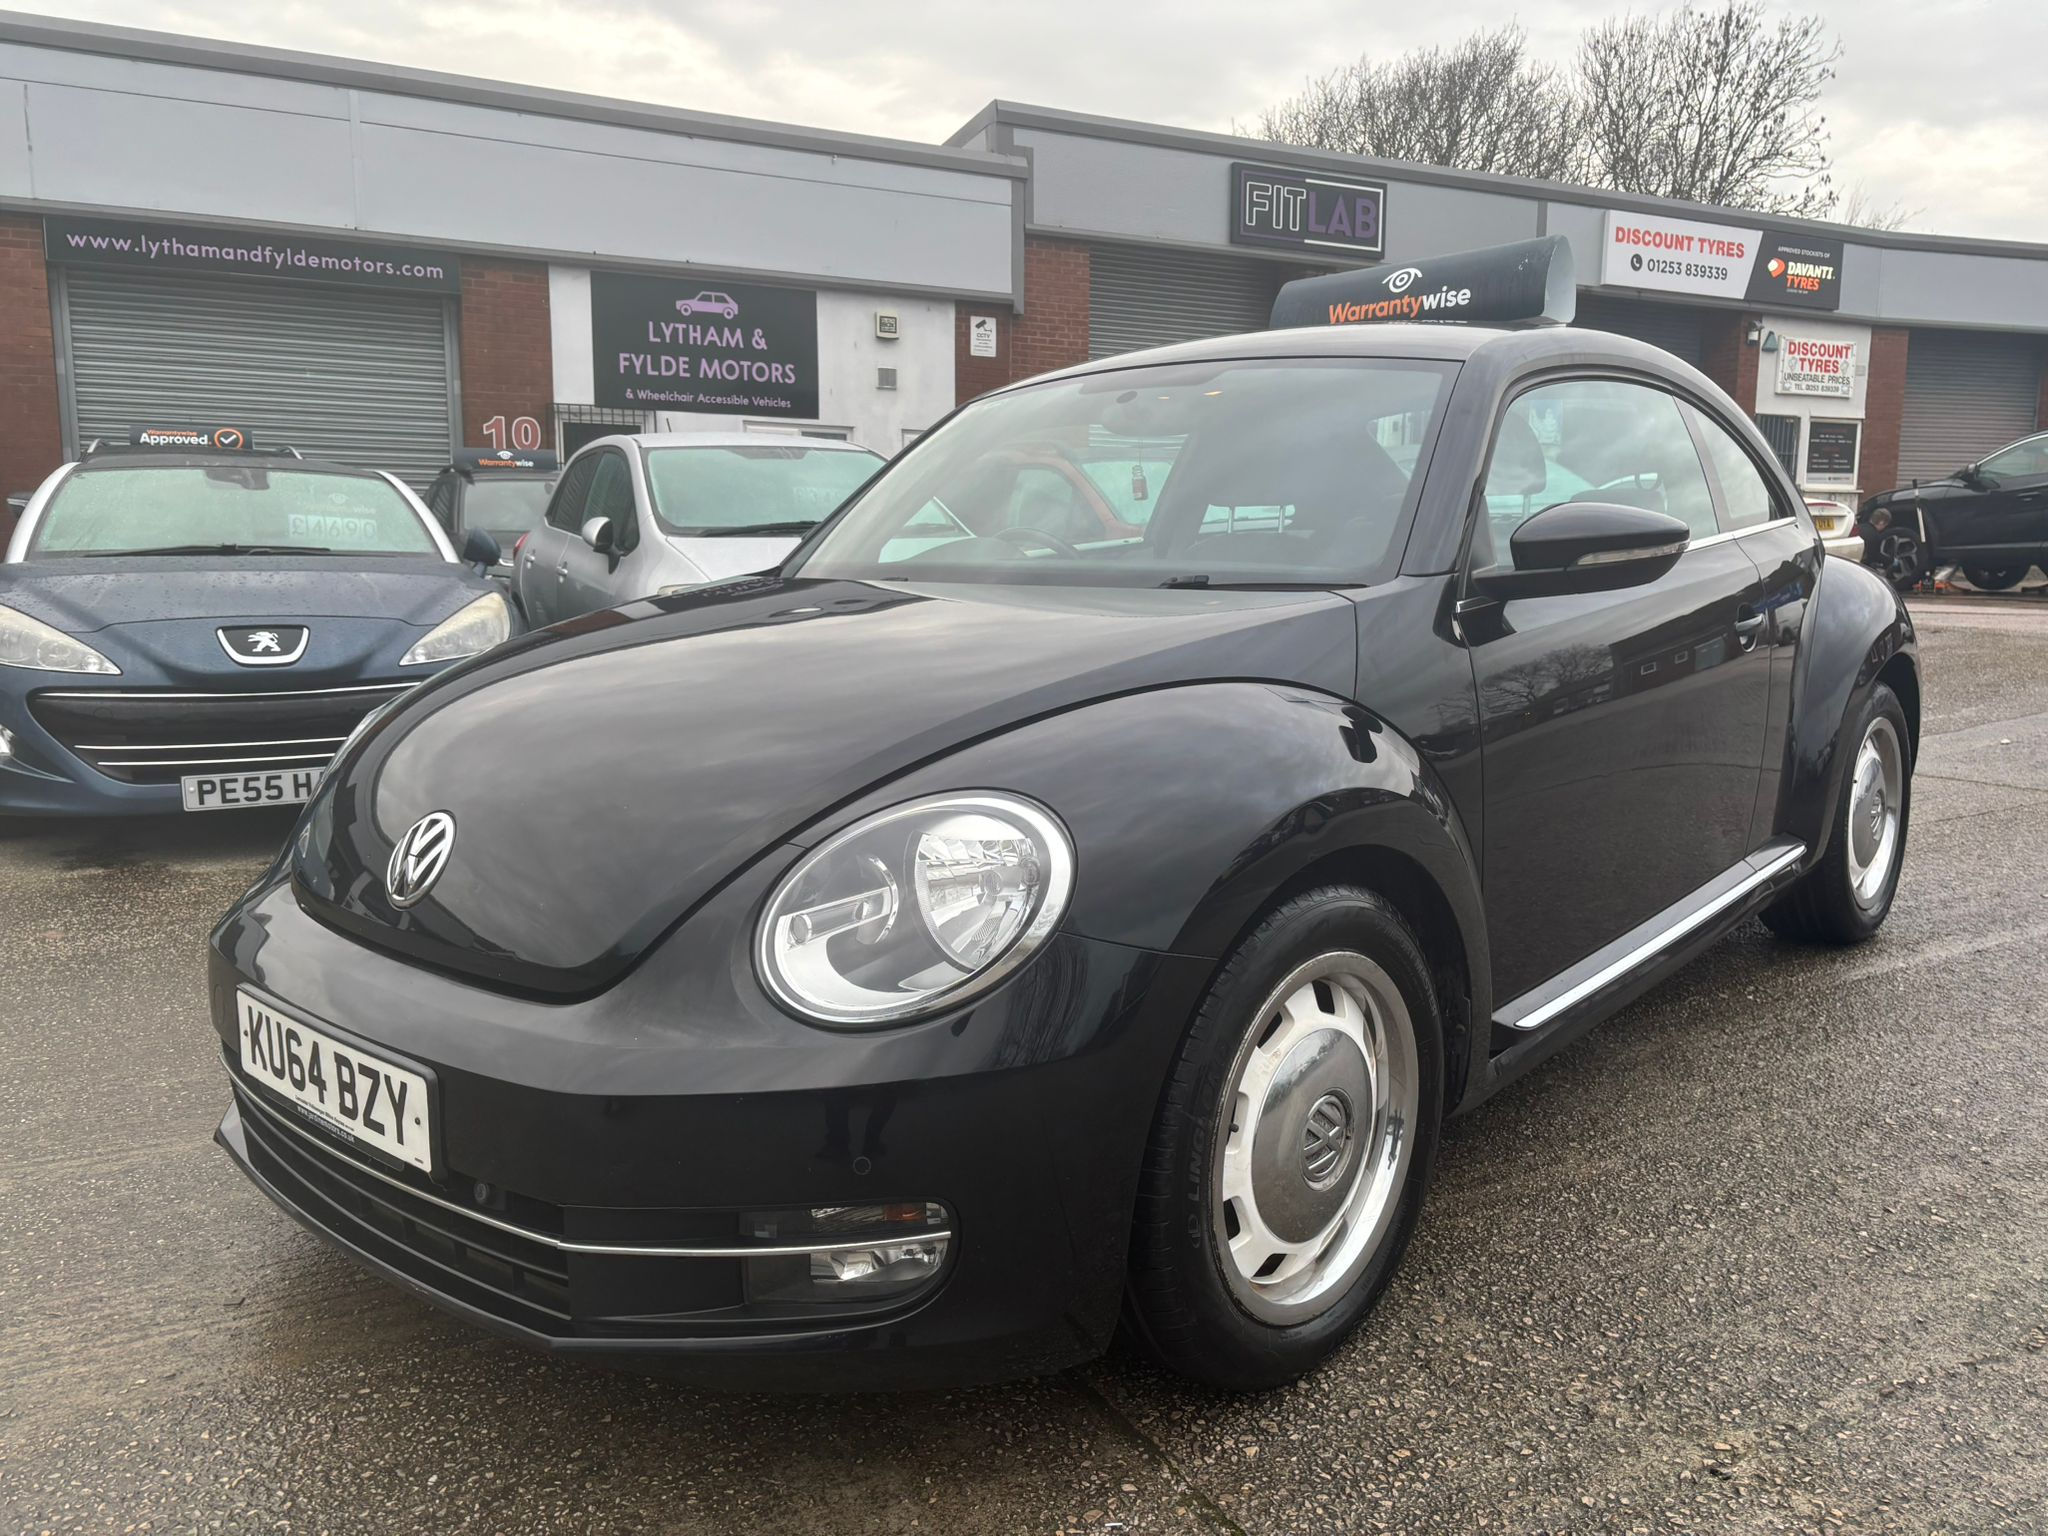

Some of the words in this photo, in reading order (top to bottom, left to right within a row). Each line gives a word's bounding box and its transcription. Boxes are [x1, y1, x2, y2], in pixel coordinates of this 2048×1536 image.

[66, 232, 444, 279] www.lythamandfyldemotors.com
[1615, 226, 1694, 252] DISCOUNT
[1698, 237, 1745, 259] TYRES
[1647, 258, 1682, 275] 01253
[1685, 263, 1728, 281] 839339
[1786, 261, 1834, 280] DAVANTI
[1786, 275, 1821, 291] TYRES
[1328, 285, 1472, 325] Warrantywise
[647, 320, 744, 350] LYTHAM
[751, 327, 767, 351] &
[1788, 341, 1851, 359] DISCOUNT
[618, 352, 691, 378] FYLDE
[698, 357, 797, 385] MOTORS
[1798, 358, 1840, 374] TYRES
[1827, 375, 1851, 385] PRICES
[625, 388, 634, 400] &
[636, 388, 694, 403] Wheelchair
[697, 392, 750, 407] Accessible
[752, 395, 792, 409] Vehicles
[482, 415, 541, 450] 10
[196, 774, 284, 806] PE55
[292, 771, 325, 799] H
[247, 1005, 328, 1105] KU64
[333, 1051, 408, 1146] BZY
